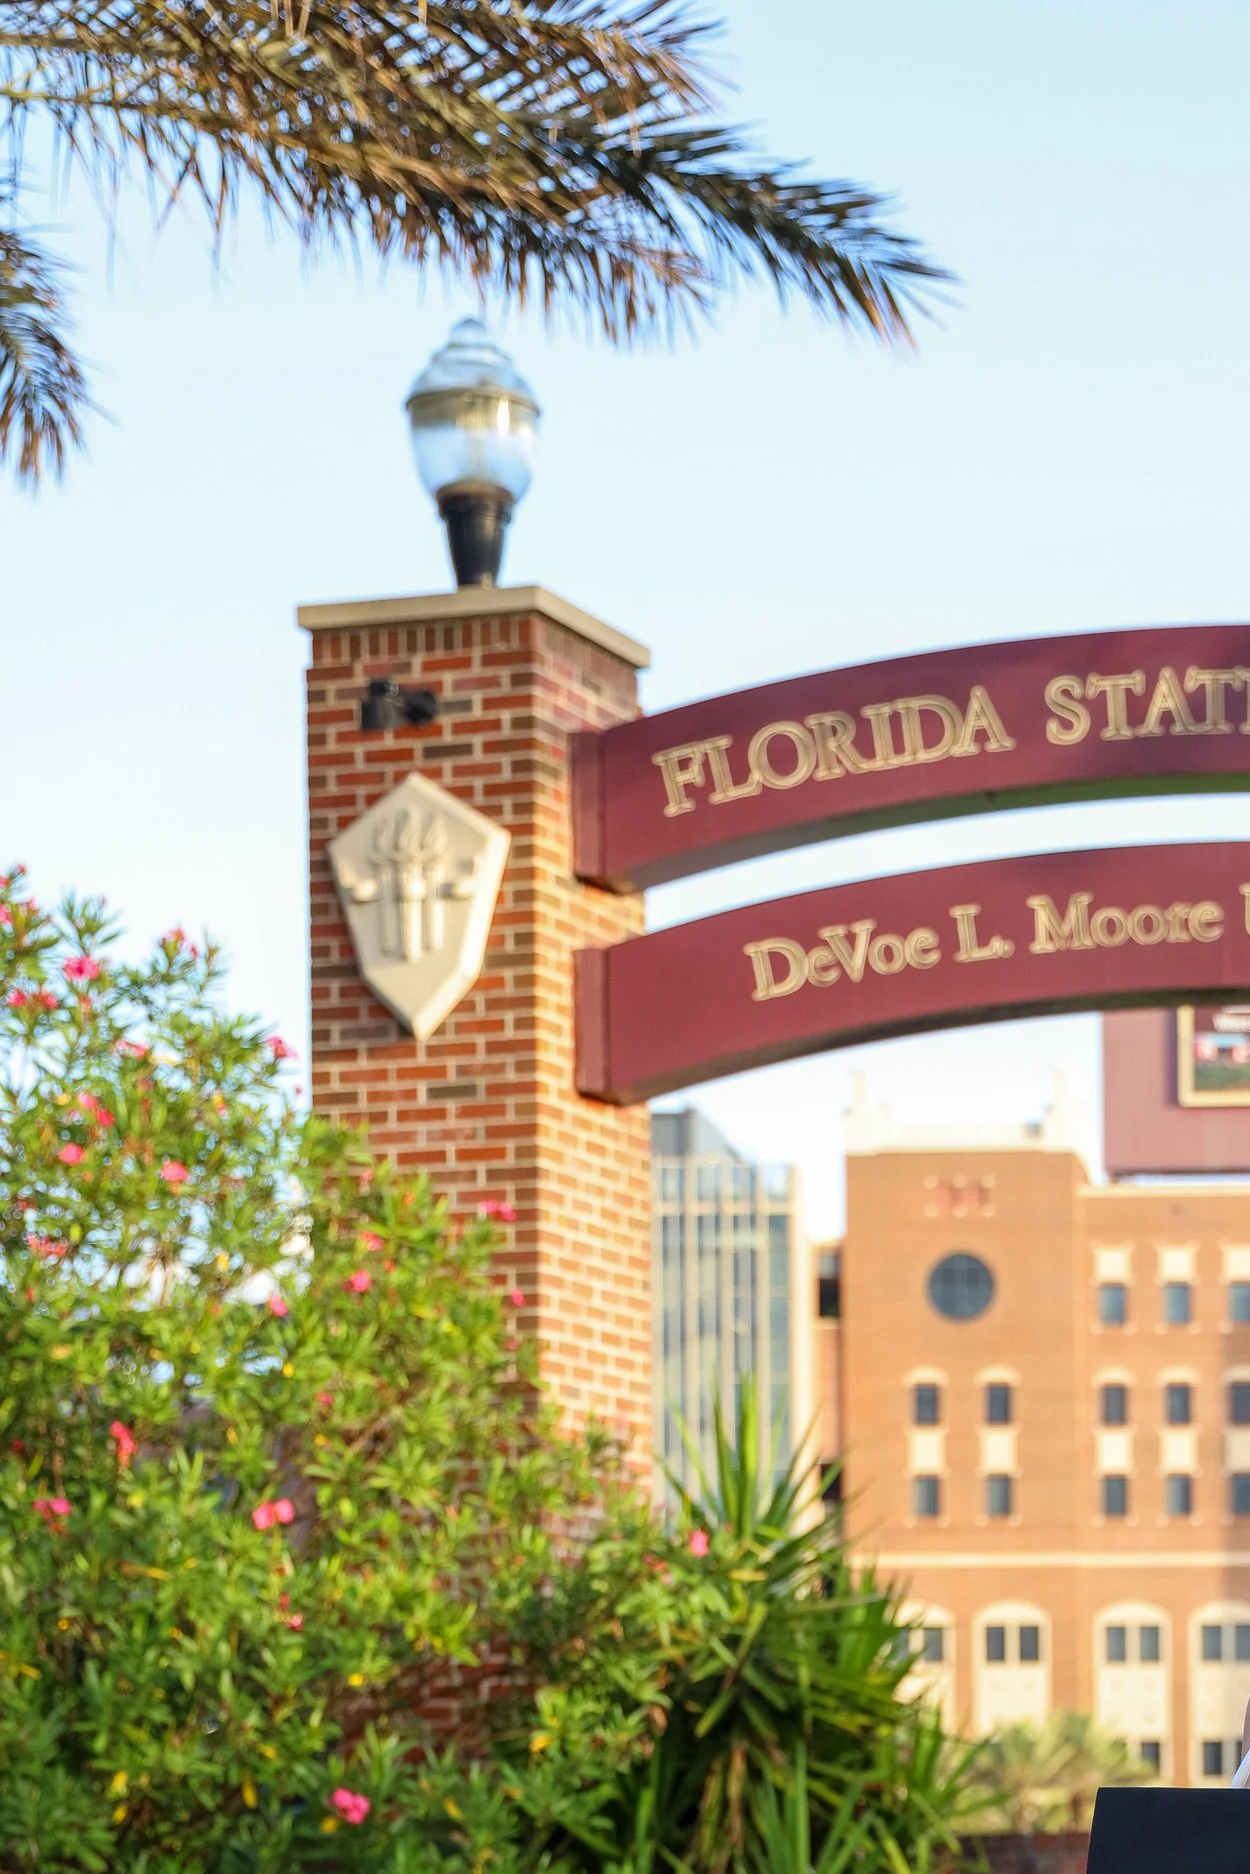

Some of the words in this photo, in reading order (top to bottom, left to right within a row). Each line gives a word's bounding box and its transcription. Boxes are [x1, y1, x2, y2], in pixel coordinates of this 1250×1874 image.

[651, 685, 1016, 818] FLORIDA
[743, 919, 941, 1002] DeVoe
[1026, 891, 1225, 956] Moore
